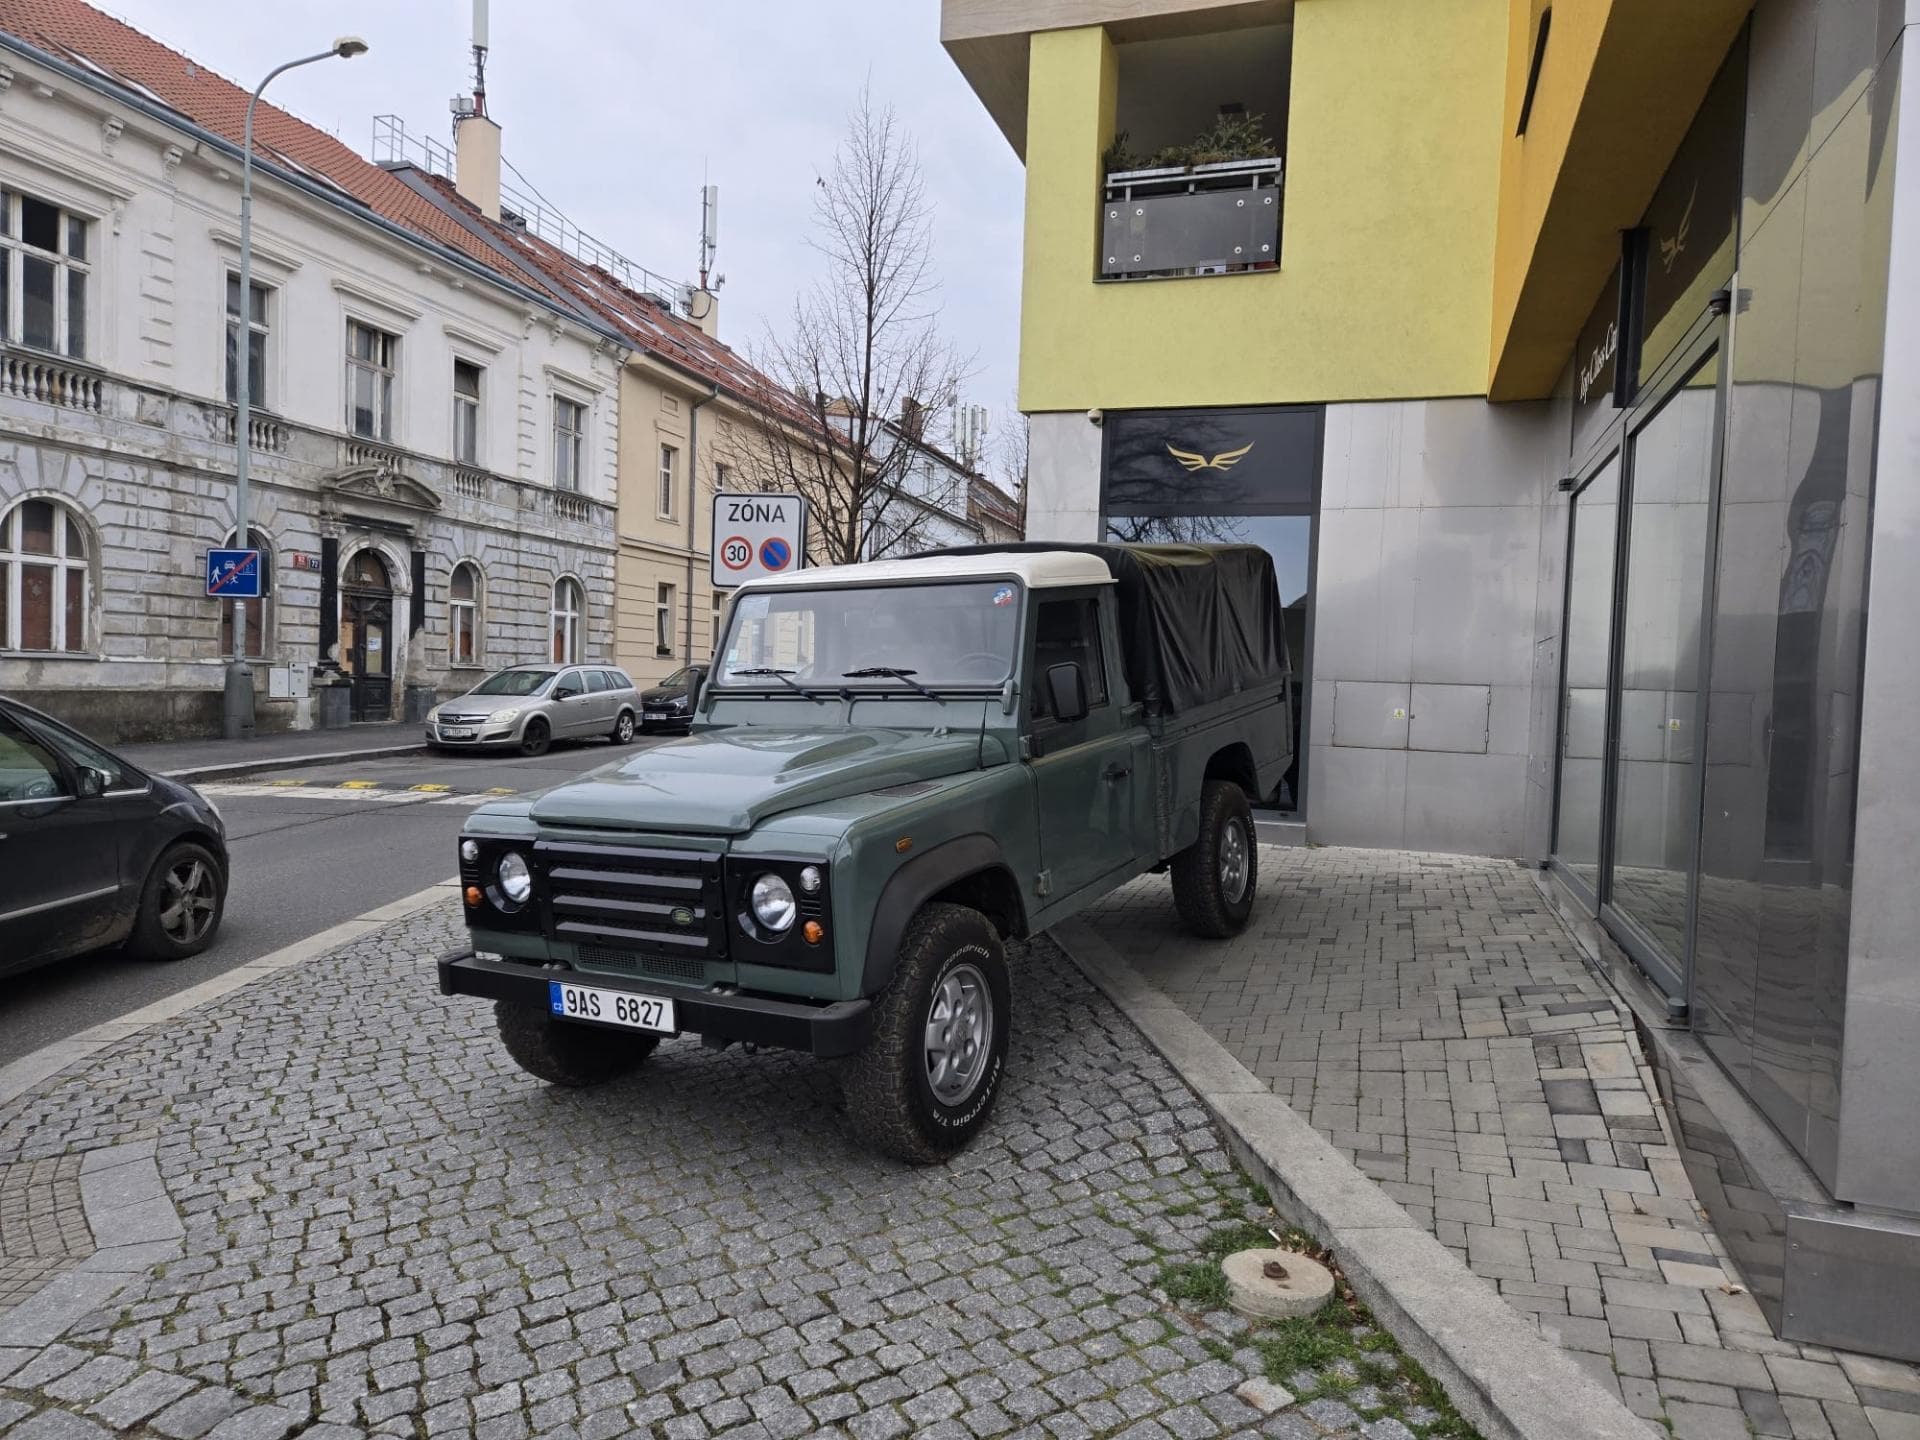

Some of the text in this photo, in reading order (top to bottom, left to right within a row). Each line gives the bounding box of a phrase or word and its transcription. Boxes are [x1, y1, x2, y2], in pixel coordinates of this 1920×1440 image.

[727, 498, 786, 523] ZÓNA
[727, 544, 747, 562] 30
[553, 1002, 563, 1011] CZ
[565, 989, 664, 1028] 9AS 6827
